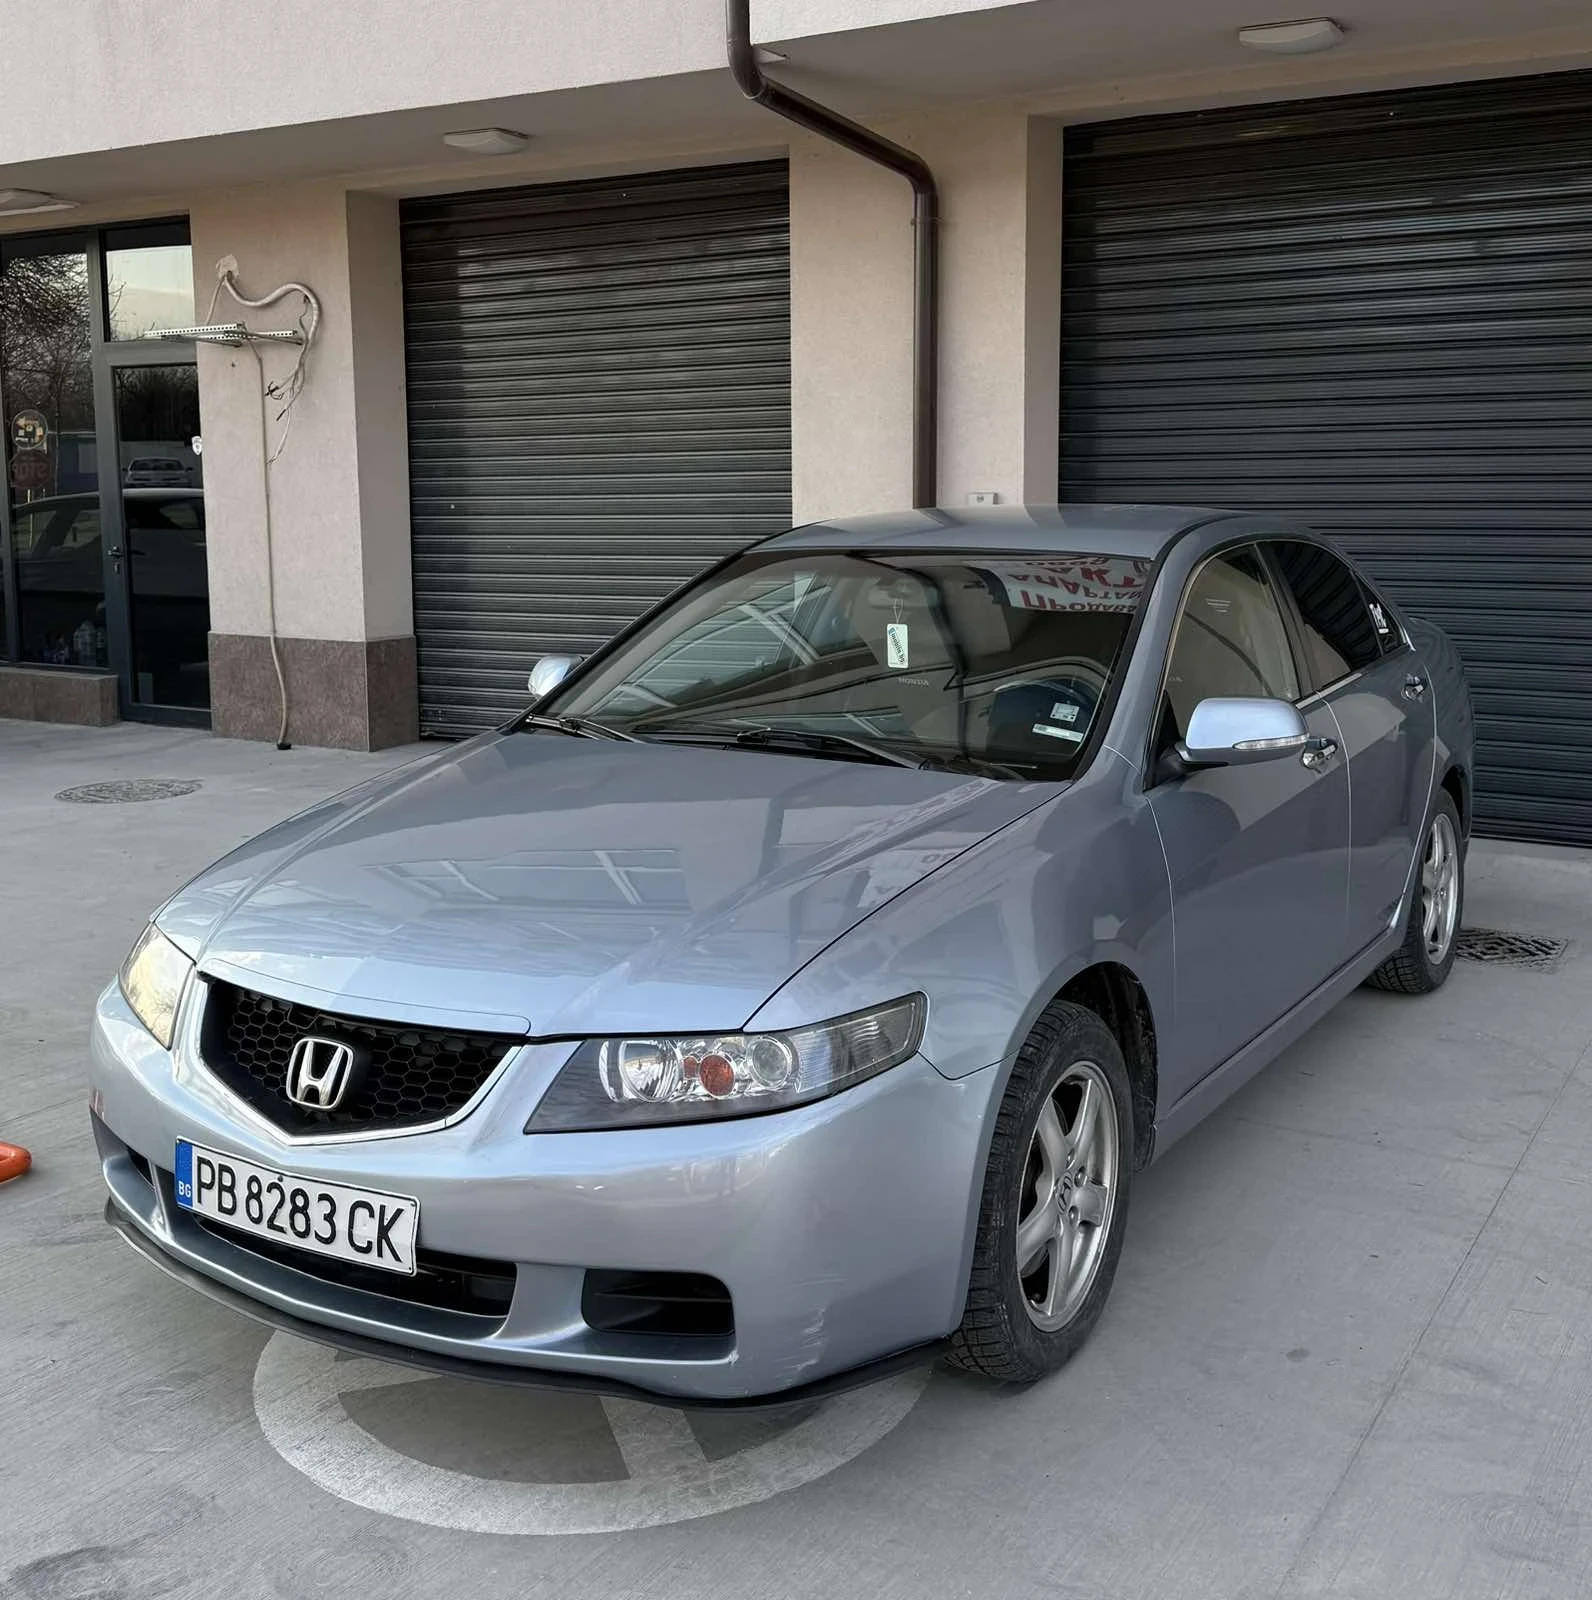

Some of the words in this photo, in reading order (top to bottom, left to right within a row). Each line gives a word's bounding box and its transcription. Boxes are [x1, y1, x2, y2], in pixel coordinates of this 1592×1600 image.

[177, 1180, 192, 1198] BG
[197, 1156, 237, 1216] PB
[245, 1175, 336, 1245] 8283
[348, 1200, 404, 1263] CK
